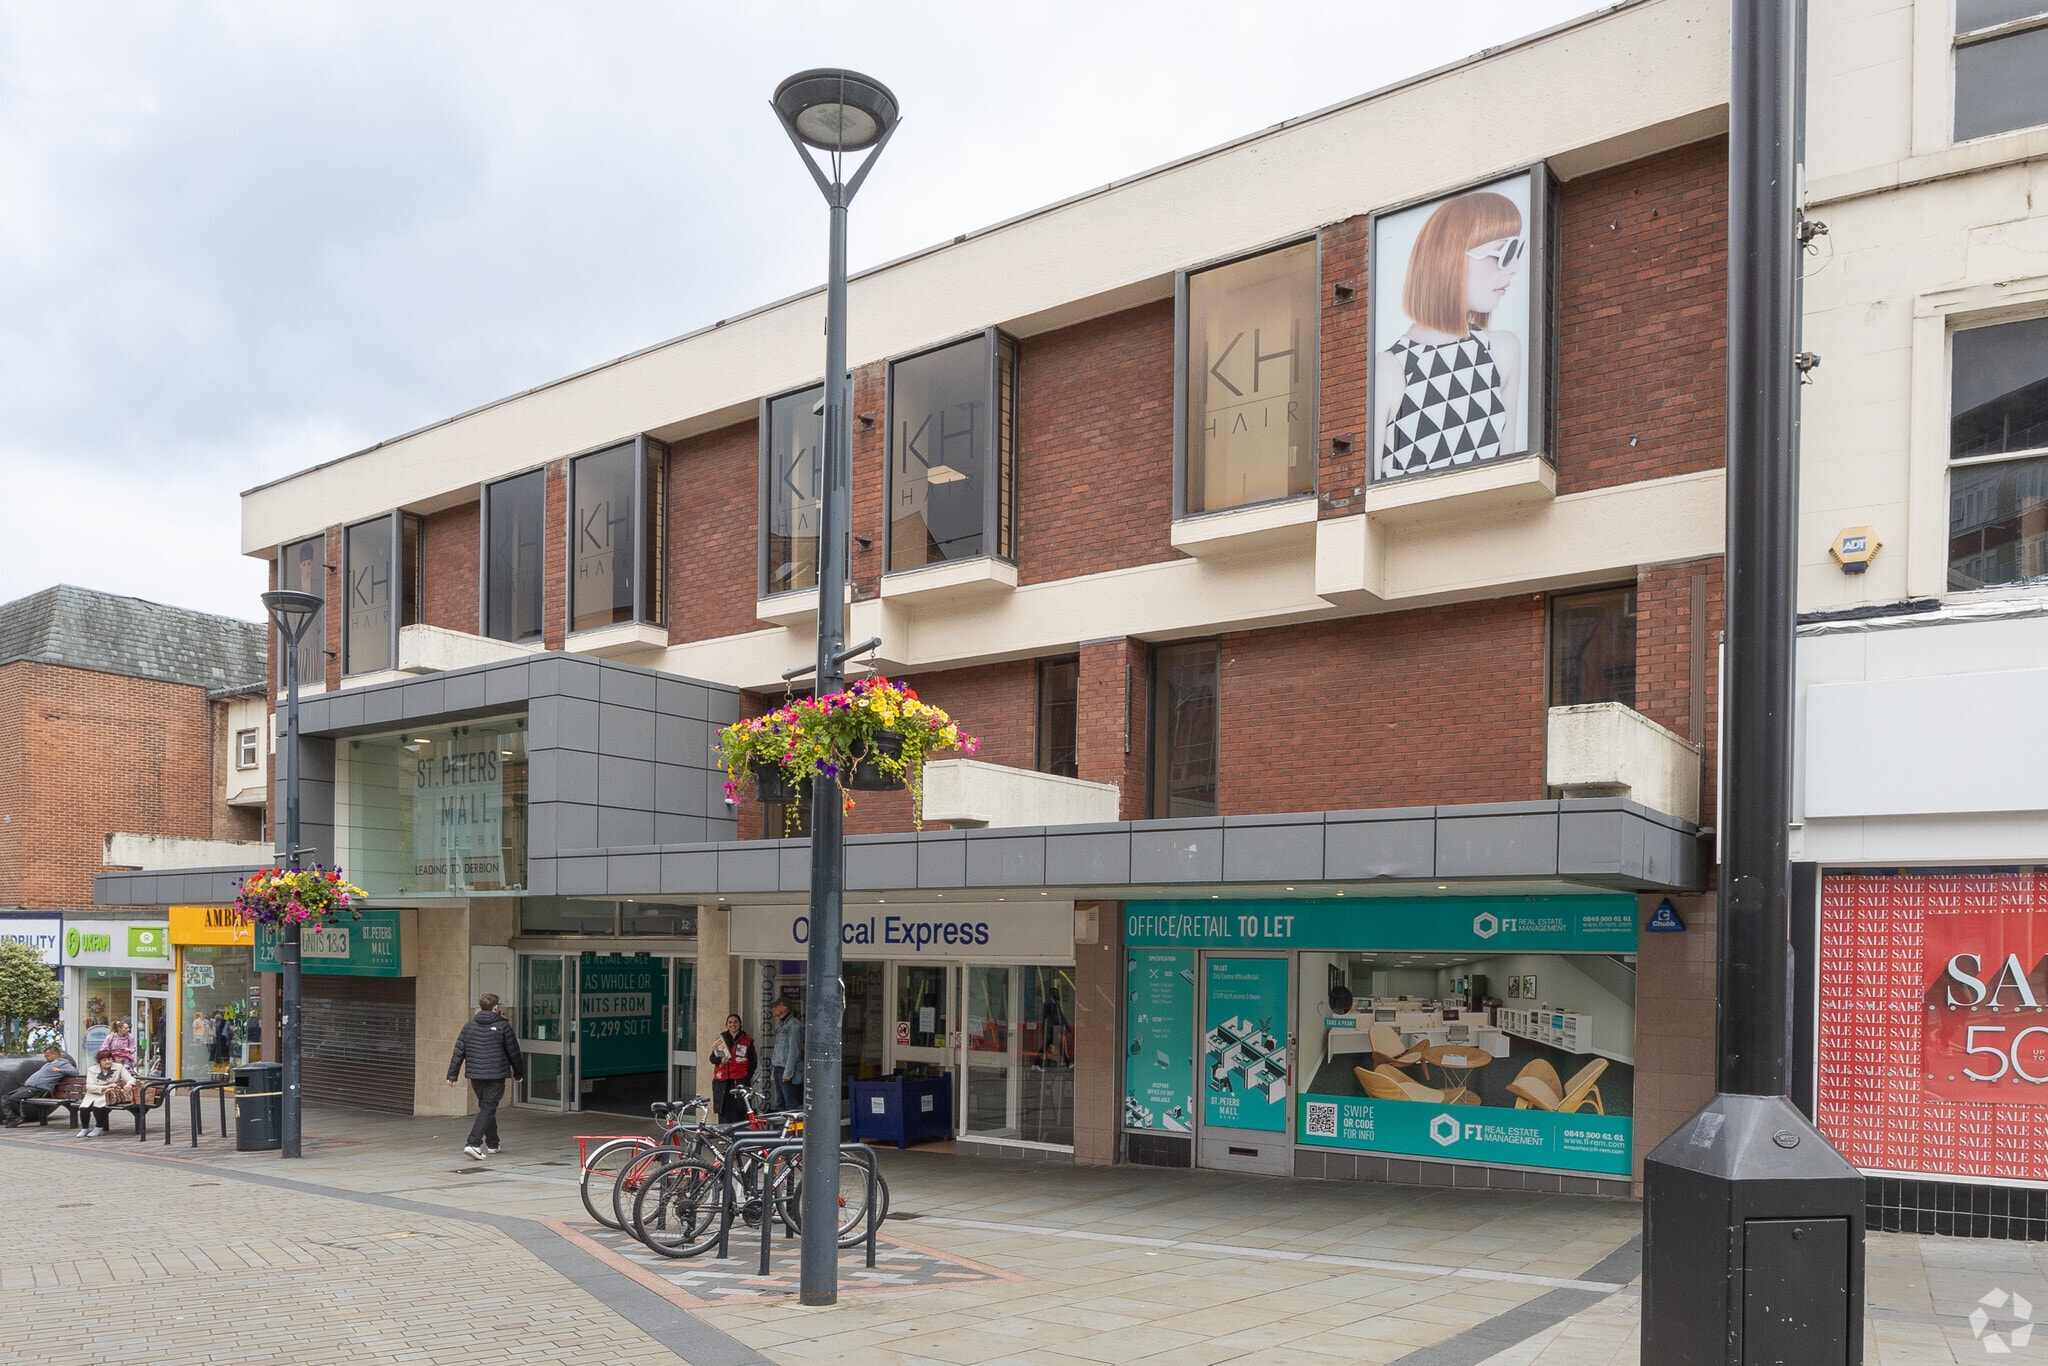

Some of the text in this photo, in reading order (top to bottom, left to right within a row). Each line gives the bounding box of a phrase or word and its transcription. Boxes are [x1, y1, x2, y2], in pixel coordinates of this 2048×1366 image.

[1203, 318, 1300, 404] KH
[1204, 401, 1299, 438] HAIR
[903, 403, 975, 474] KH
[580, 495, 630, 553] KH
[1843, 539, 1866, 551] ADT
[352, 560, 389, 609] KH
[351, 609, 390, 631] HAIR
[441, 834, 497, 847] DERBY
[415, 862, 499, 875] LEADING TO DERBION
[1825, 881, 2034, 893] SALE SALE SALE SALE SALE SALE
[1825, 895, 2034, 906] SALE SALE SALE SALE SALE SALE
[793, 916, 989, 951] Ocal Express
[1128, 914, 1295, 938] OFFICE/RETAIL TO LET
[1502, 918, 1517, 932] FI
[1824, 923, 1923, 932] SALE SALE SALE
[82, 934, 111, 952] OXFAM
[327, 933, 347, 953] 1&3
[1823, 962, 1923, 972] SALE SALE SALE
[585, 974, 598, 990] AS
[601, 974, 635, 990] WHOLE
[638, 973, 651, 989] OR
[1947, 953, 2048, 1007] SA
[1823, 987, 1924, 998] SALE SALE SALE
[582, 997, 610, 1014] NITS
[614, 996, 645, 1013] FROM
[762, 964, 777, 1039] Contact
[624, 1020, 637, 1036] SQ
[641, 1019, 651, 1035] FT
[1343, 1105, 1374, 1119] SWIPE
[1820, 1103, 2029, 1121] SALE SALE SALE SALE SALE SALE
[1343, 1118, 1374, 1129] QR CODE
[1484, 1125, 1539, 1138] REAL ESTATE
[1819, 1115, 2029, 1135] SALE SALE SALE SALE SALE SALE
[1343, 1128, 1375, 1140] FOR INFO
[1464, 1124, 1482, 1141] FI
[1484, 1133, 1544, 1146] MANAGEMENT
[1564, 1130, 1584, 1138] 0845
[1586, 1131, 1601, 1139] 500
[1853, 1131, 1883, 1140] SALE
[1888, 1133, 1919, 1142] SALE
[1923, 1135, 1954, 1145] SALE
[1959, 1137, 1991, 1147] SALE
[1996, 1139, 2029, 1149] SALE
[1563, 1137, 1625, 1148] www.fi-rem.com
[1853, 1143, 1883, 1153] SALE
[1888, 1146, 1918, 1156] SALE
[1923, 1149, 1954, 1158] SALE
[1959, 1151, 1991, 1161] SALE
[1996, 1152, 2028, 1162] SALE
[1852, 1156, 2028, 1176] SALE SALE SALE SALE SALE
